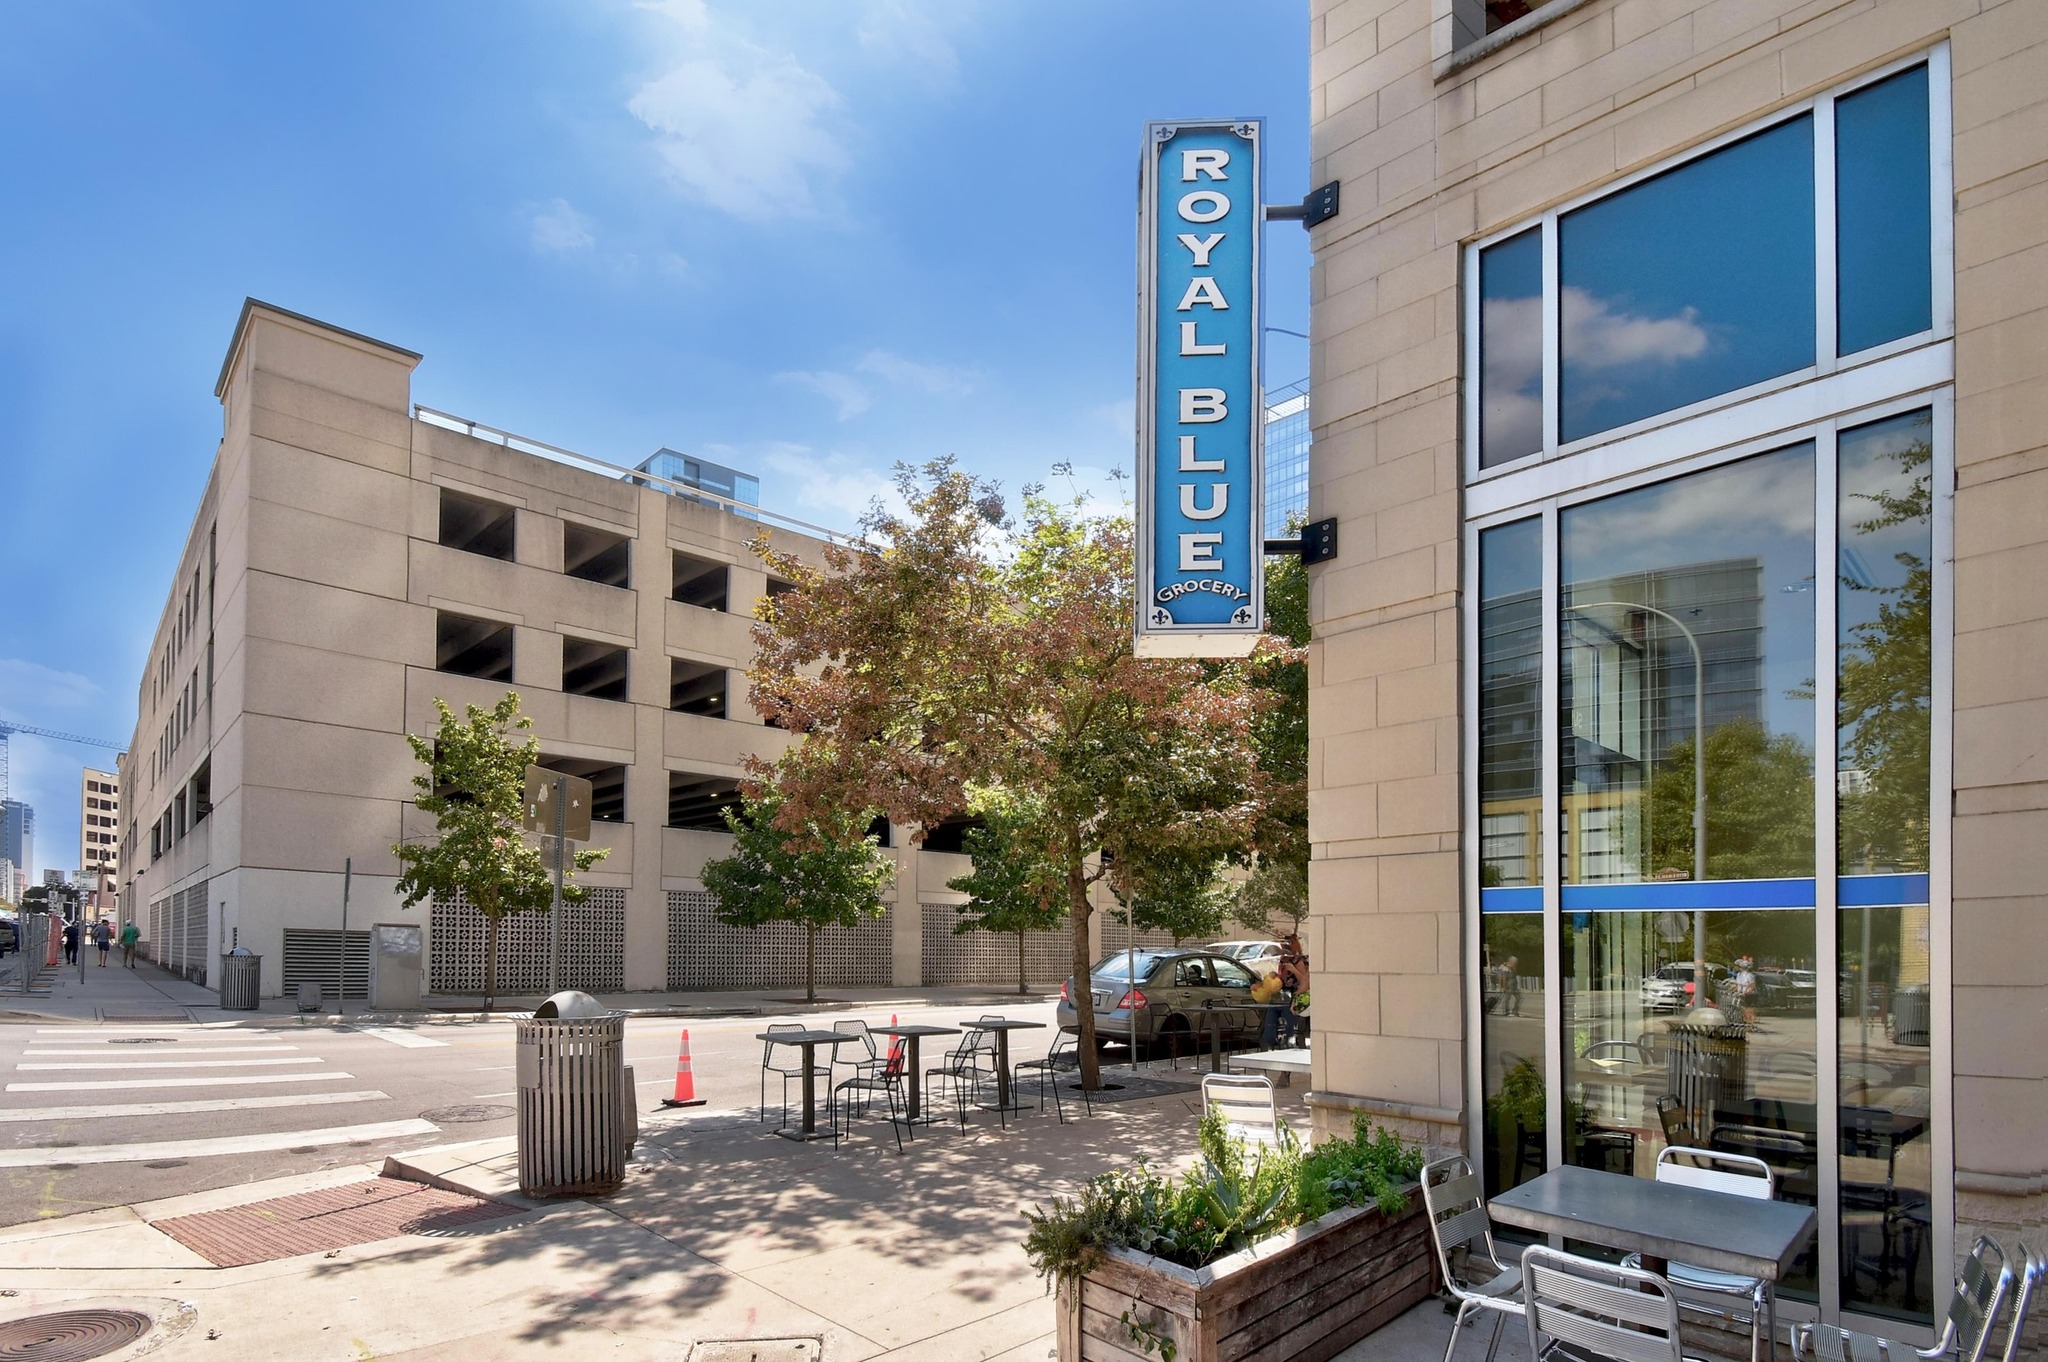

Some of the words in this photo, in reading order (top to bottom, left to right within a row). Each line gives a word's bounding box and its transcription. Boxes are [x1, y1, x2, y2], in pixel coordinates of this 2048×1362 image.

[1177, 149, 1231, 356] ROYAL
[1178, 388, 1229, 571] BLUE
[1156, 579, 1248, 602] GROCERY
